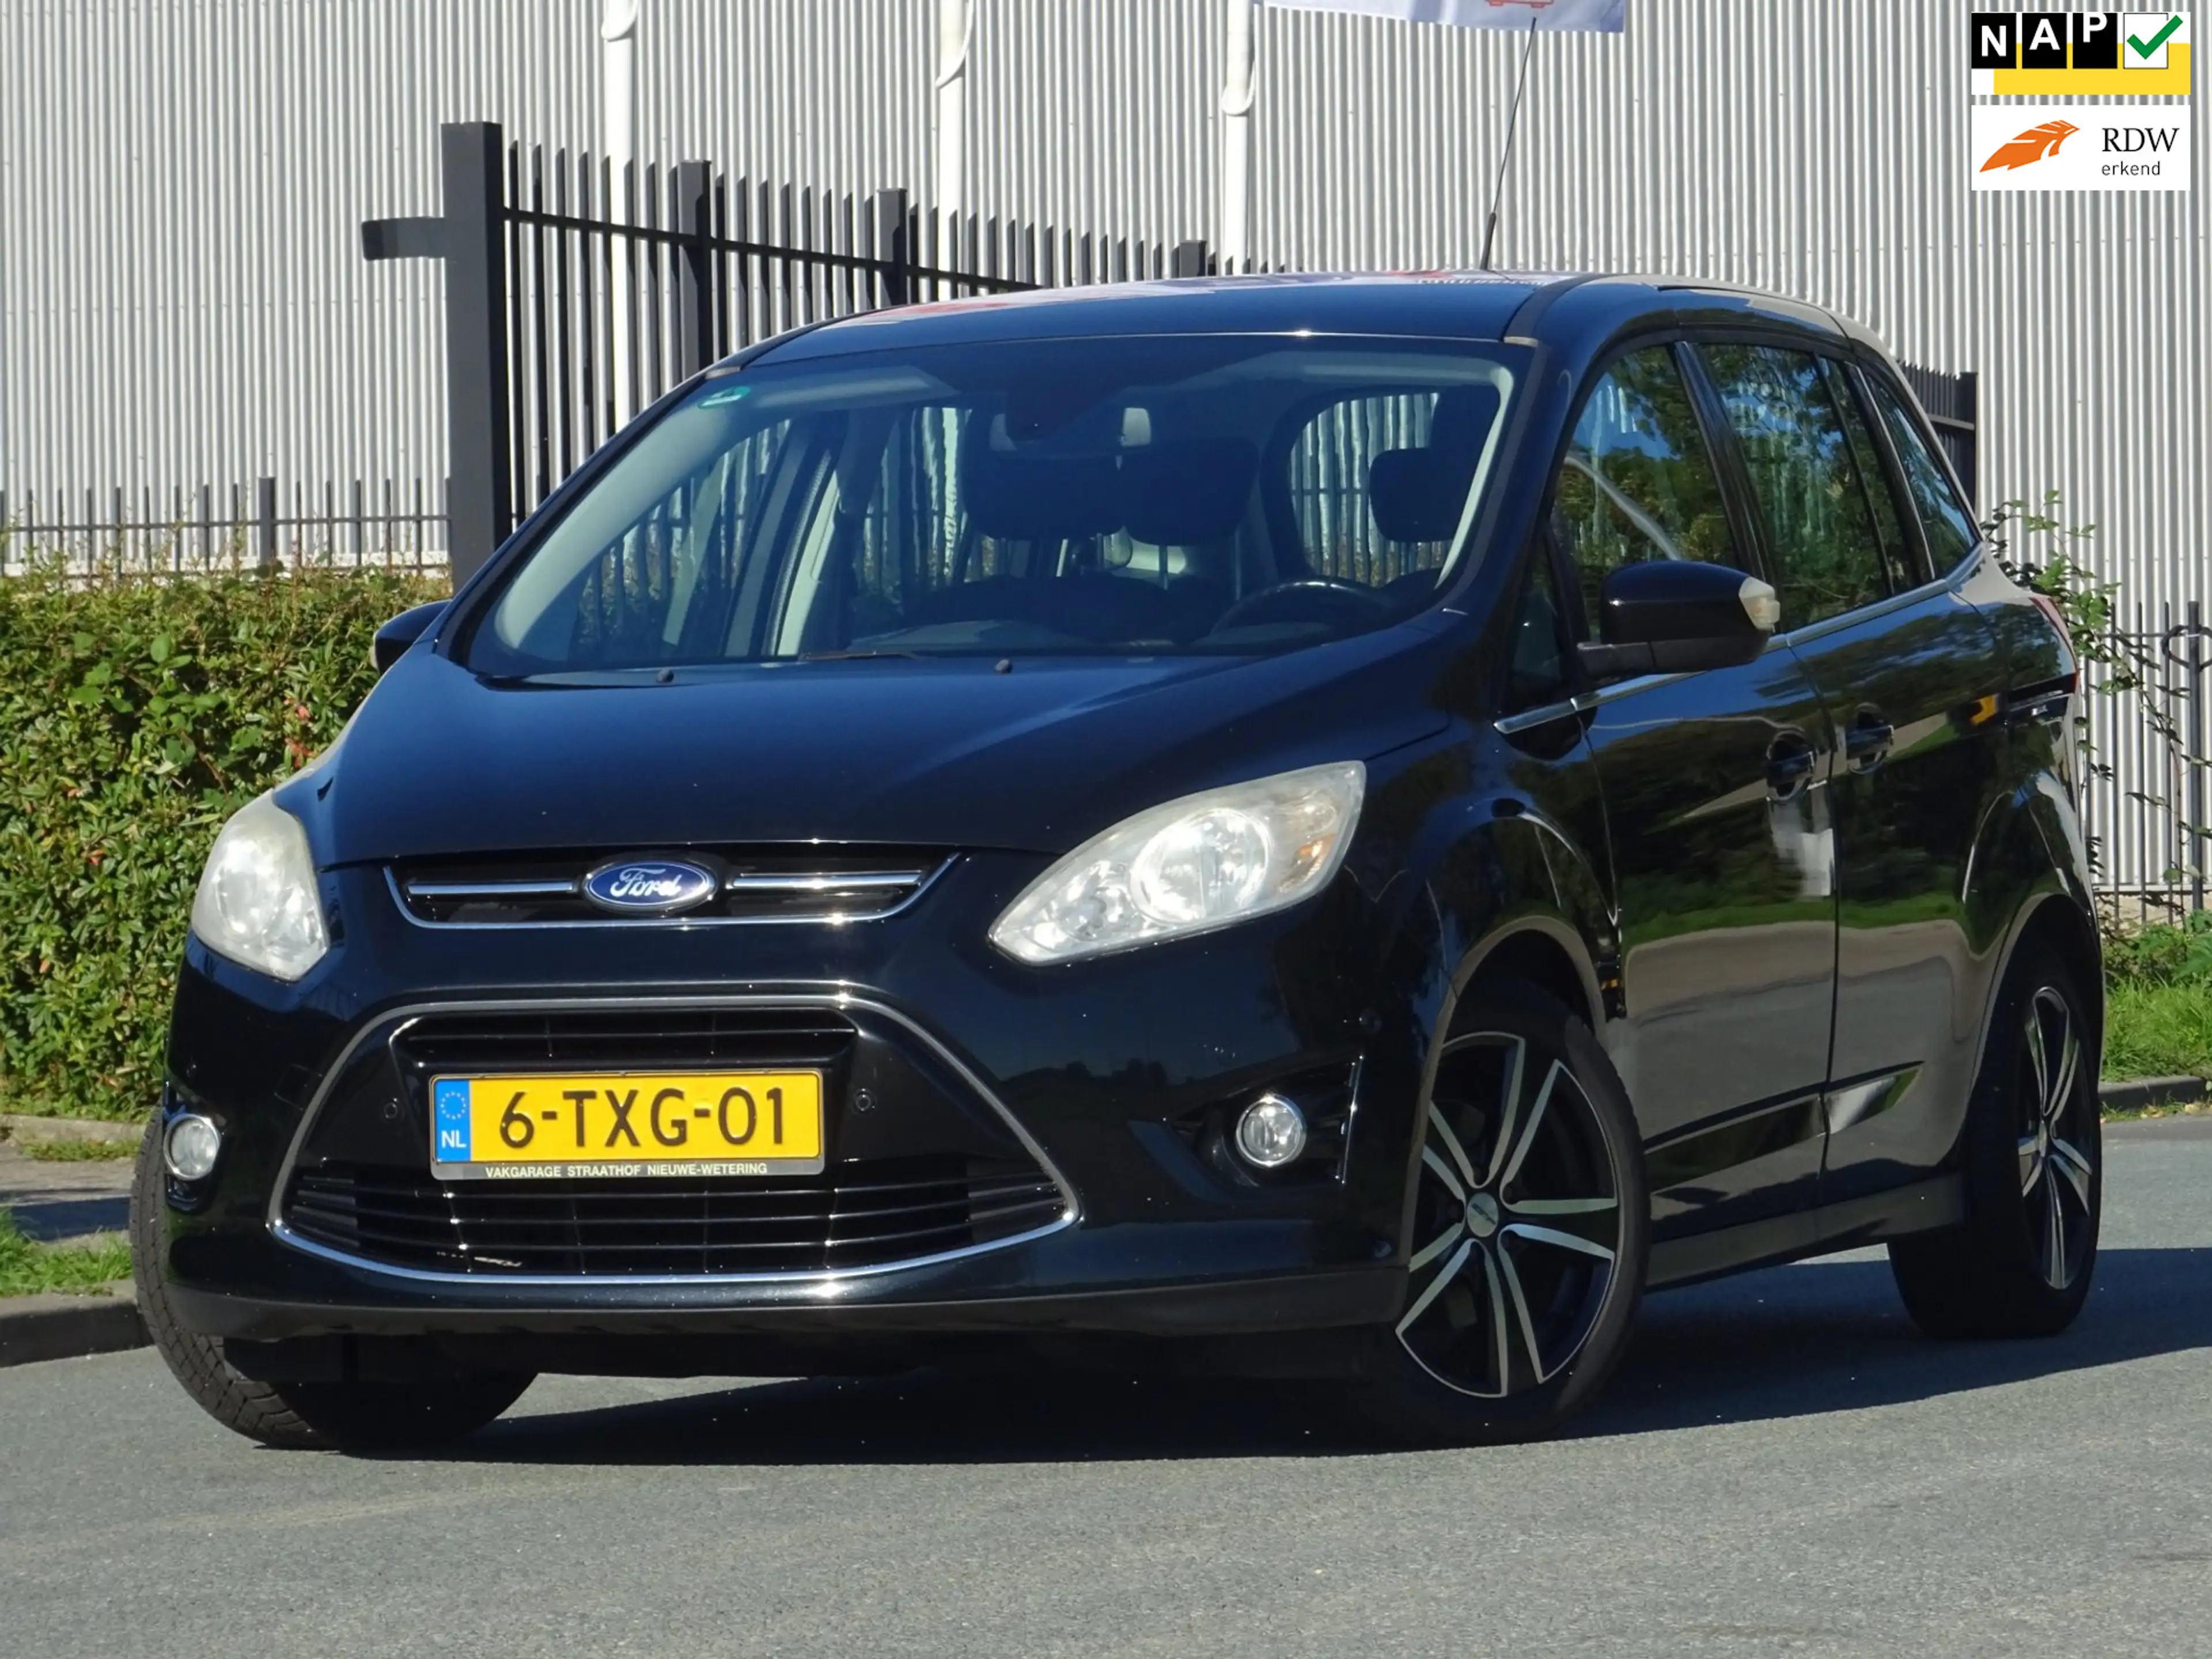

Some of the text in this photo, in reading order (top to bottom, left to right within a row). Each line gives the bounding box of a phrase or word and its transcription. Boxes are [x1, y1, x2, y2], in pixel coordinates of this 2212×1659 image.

[610, 868, 682, 897] Ford
[499, 1087, 783, 1149] 6-TXG-01
[441, 1130, 467, 1148] NL
[486, 1163, 767, 1177] VAKGARAGE STRAATHOF NIEUWE-WETERING
